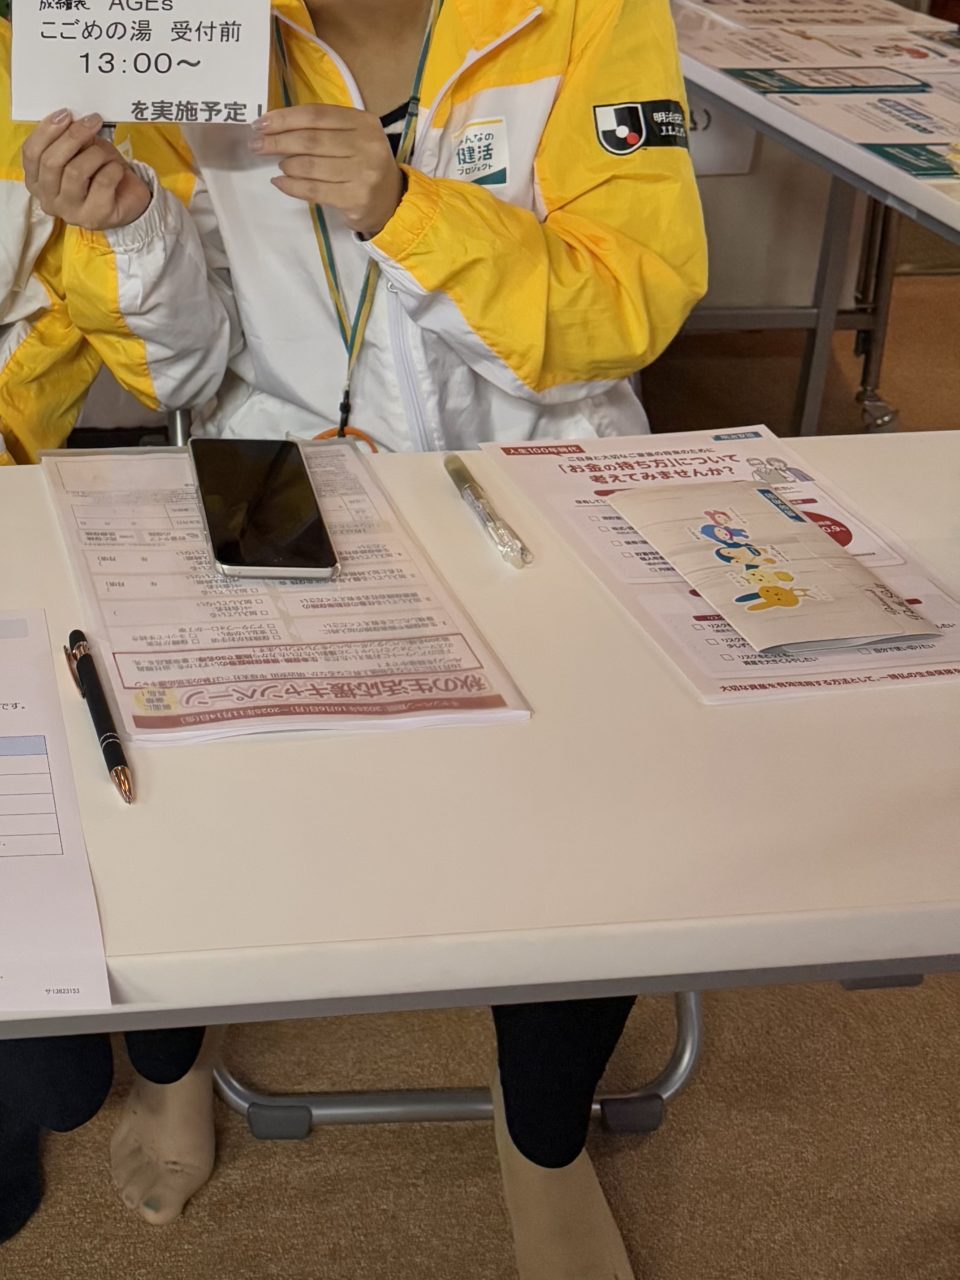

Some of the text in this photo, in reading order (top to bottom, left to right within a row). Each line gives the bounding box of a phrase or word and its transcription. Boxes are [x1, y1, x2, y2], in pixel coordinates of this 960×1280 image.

[40, 20, 243, 43] こごめの湯 受付前
[78, 52, 202, 75] 13:00～
[458, 132, 495, 146] んなの
[456, 142, 494, 166] 健活
[456, 163, 494, 176] プロジェクト
[558, 454, 741, 474] 「お金の持ち方」について
[589, 466, 735, 485] 考えてみませんか？
[184, 674, 486, 706] 秋の生活応援キャンペーン
[0, 701, 26, 711] です。
